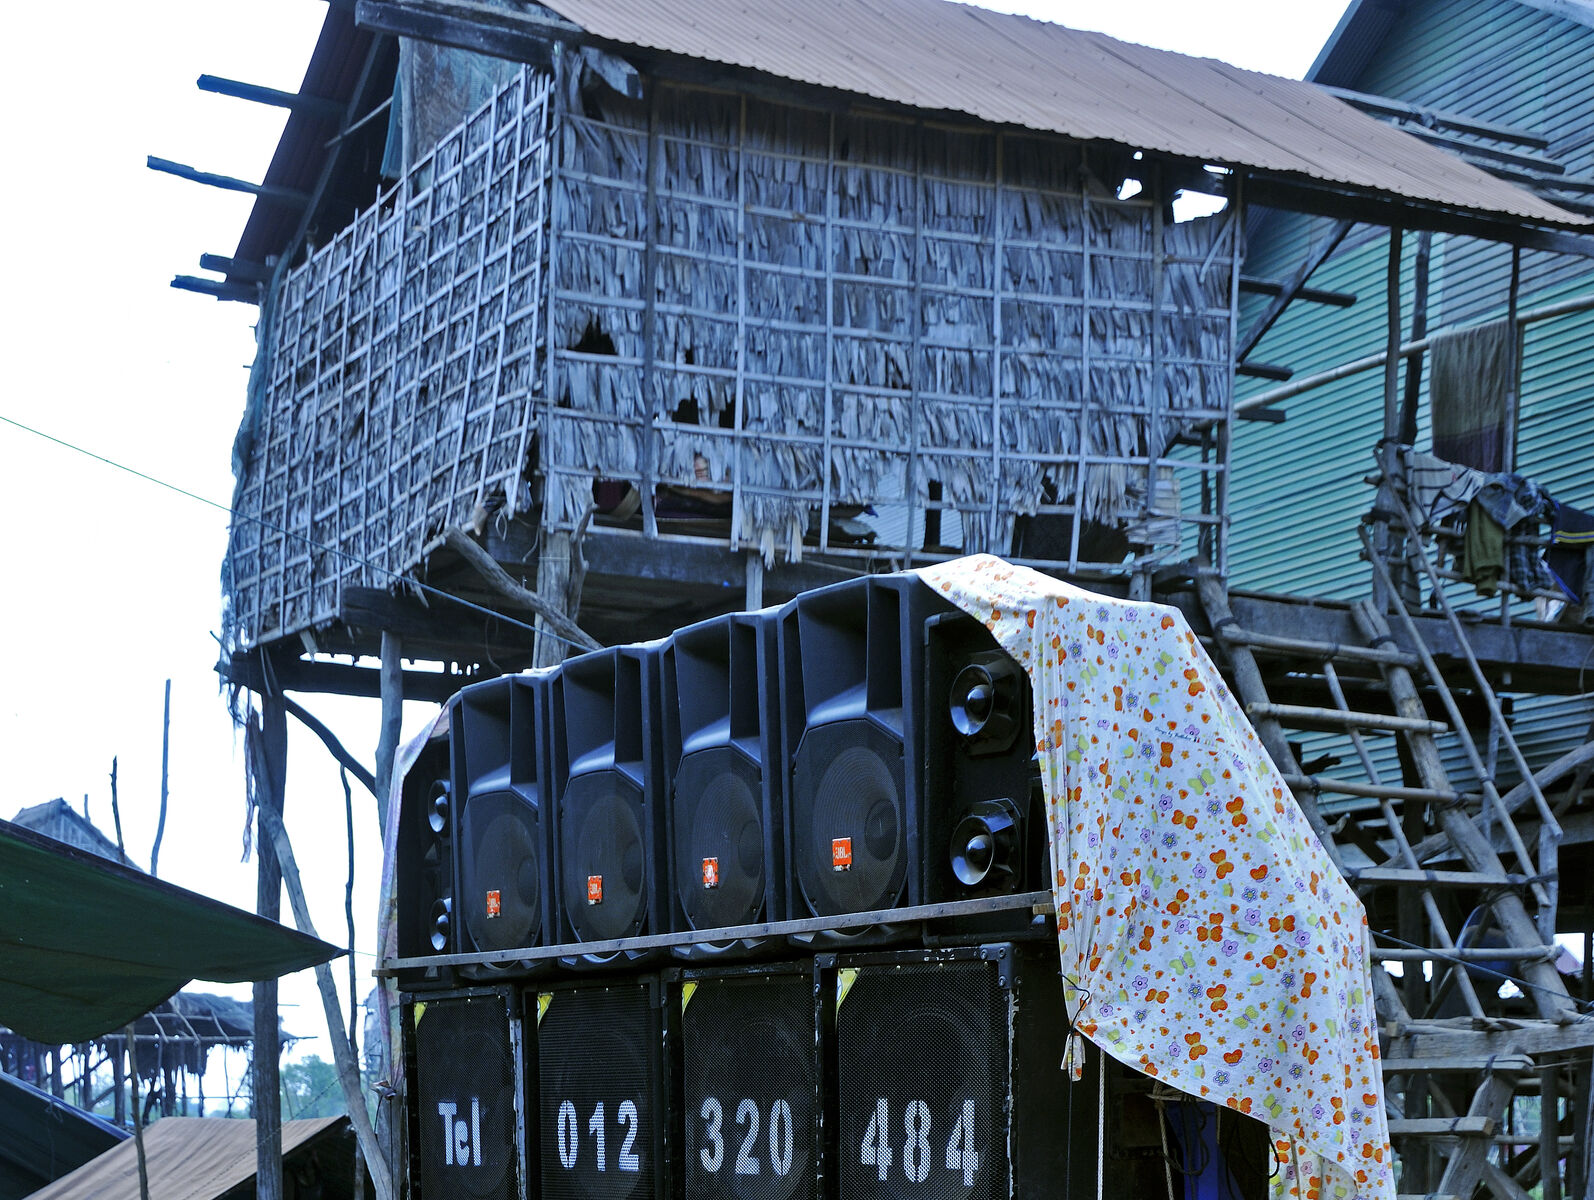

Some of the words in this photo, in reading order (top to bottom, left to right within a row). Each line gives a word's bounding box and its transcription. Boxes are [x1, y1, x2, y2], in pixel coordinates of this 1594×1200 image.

[438, 1096, 481, 1167] Tel
[557, 1099, 640, 1172] 012
[700, 1097, 794, 1177] 320
[861, 1098, 979, 1187] 484
